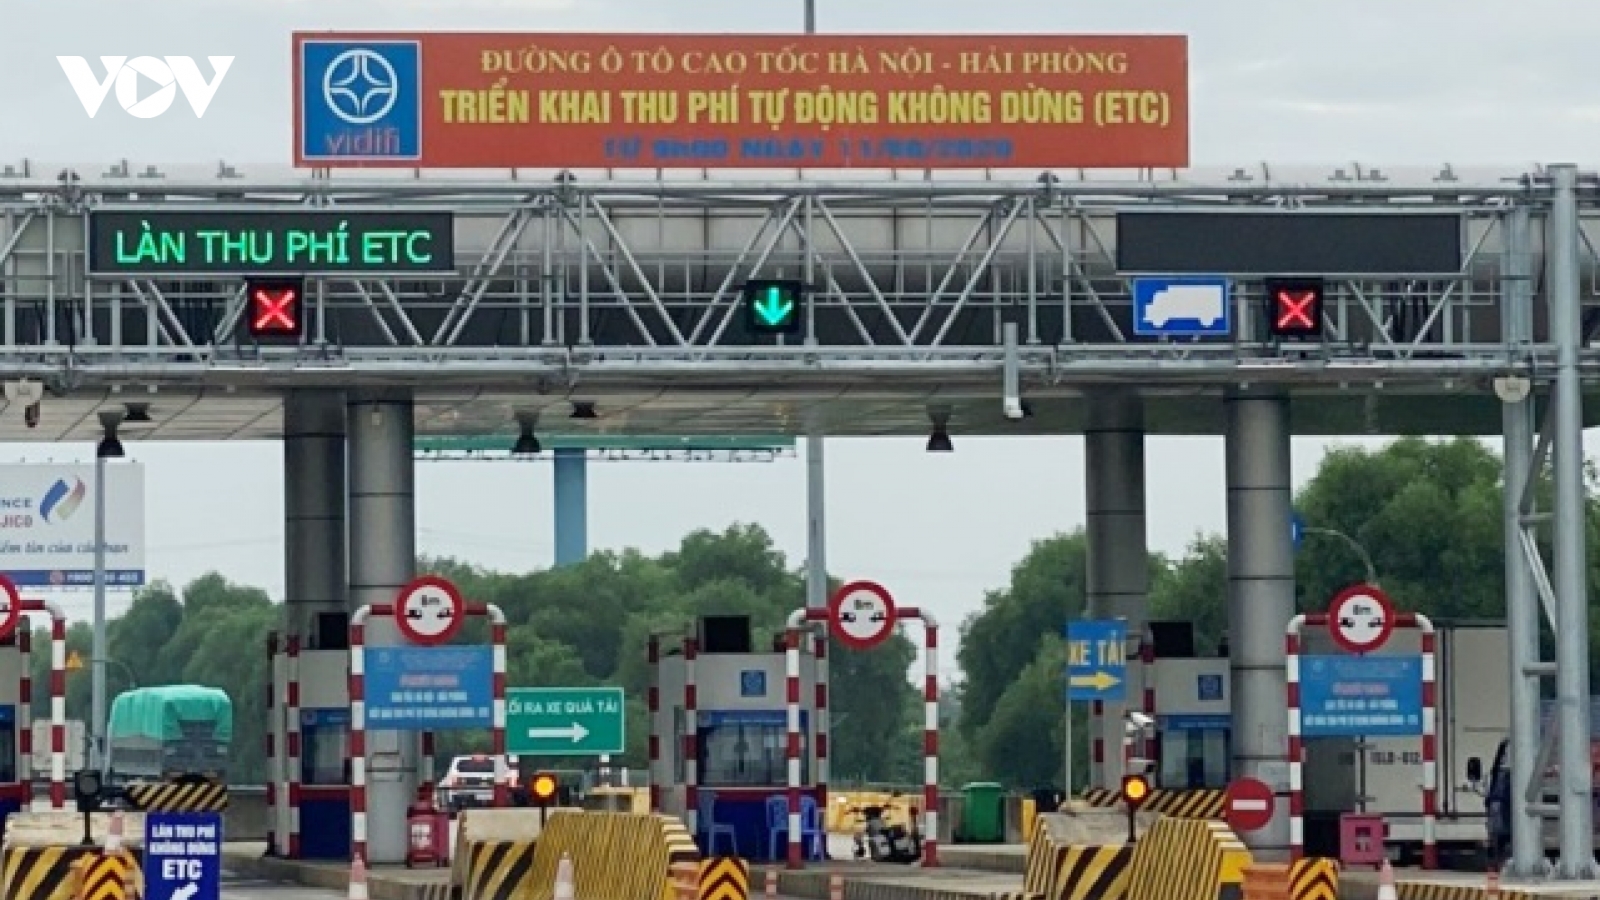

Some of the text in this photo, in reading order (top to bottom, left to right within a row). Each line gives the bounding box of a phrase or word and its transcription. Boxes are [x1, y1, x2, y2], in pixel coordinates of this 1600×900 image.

[480, 45, 590, 74] ĐƯỜNG
[601, 46, 623, 74] Ô
[631, 47, 674, 74] TÔ
[681, 51, 747, 74] CAO
[756, 44, 819, 74] TỐC
[828, 47, 870, 74] HÀ
[879, 48, 934, 79] NỘI
[960, 46, 1013, 74] HẢI
[1022, 47, 1128, 74] PHÒNG
[439, 77, 1169, 131] TRIỂN KHAI THU PHÍ TỰ ĐỘNG KHÔNG DỪNG (ETC)
[326, 128, 399, 155] vidifi
[116, 220, 431, 263] LÀN THU PHÍ ETC
[1068, 640, 1091, 666] XE
[508, 697, 522, 714] ỐI
[524, 702, 543, 714] RA
[546, 702, 562, 714] XE
[162, 859, 203, 880] ETC
